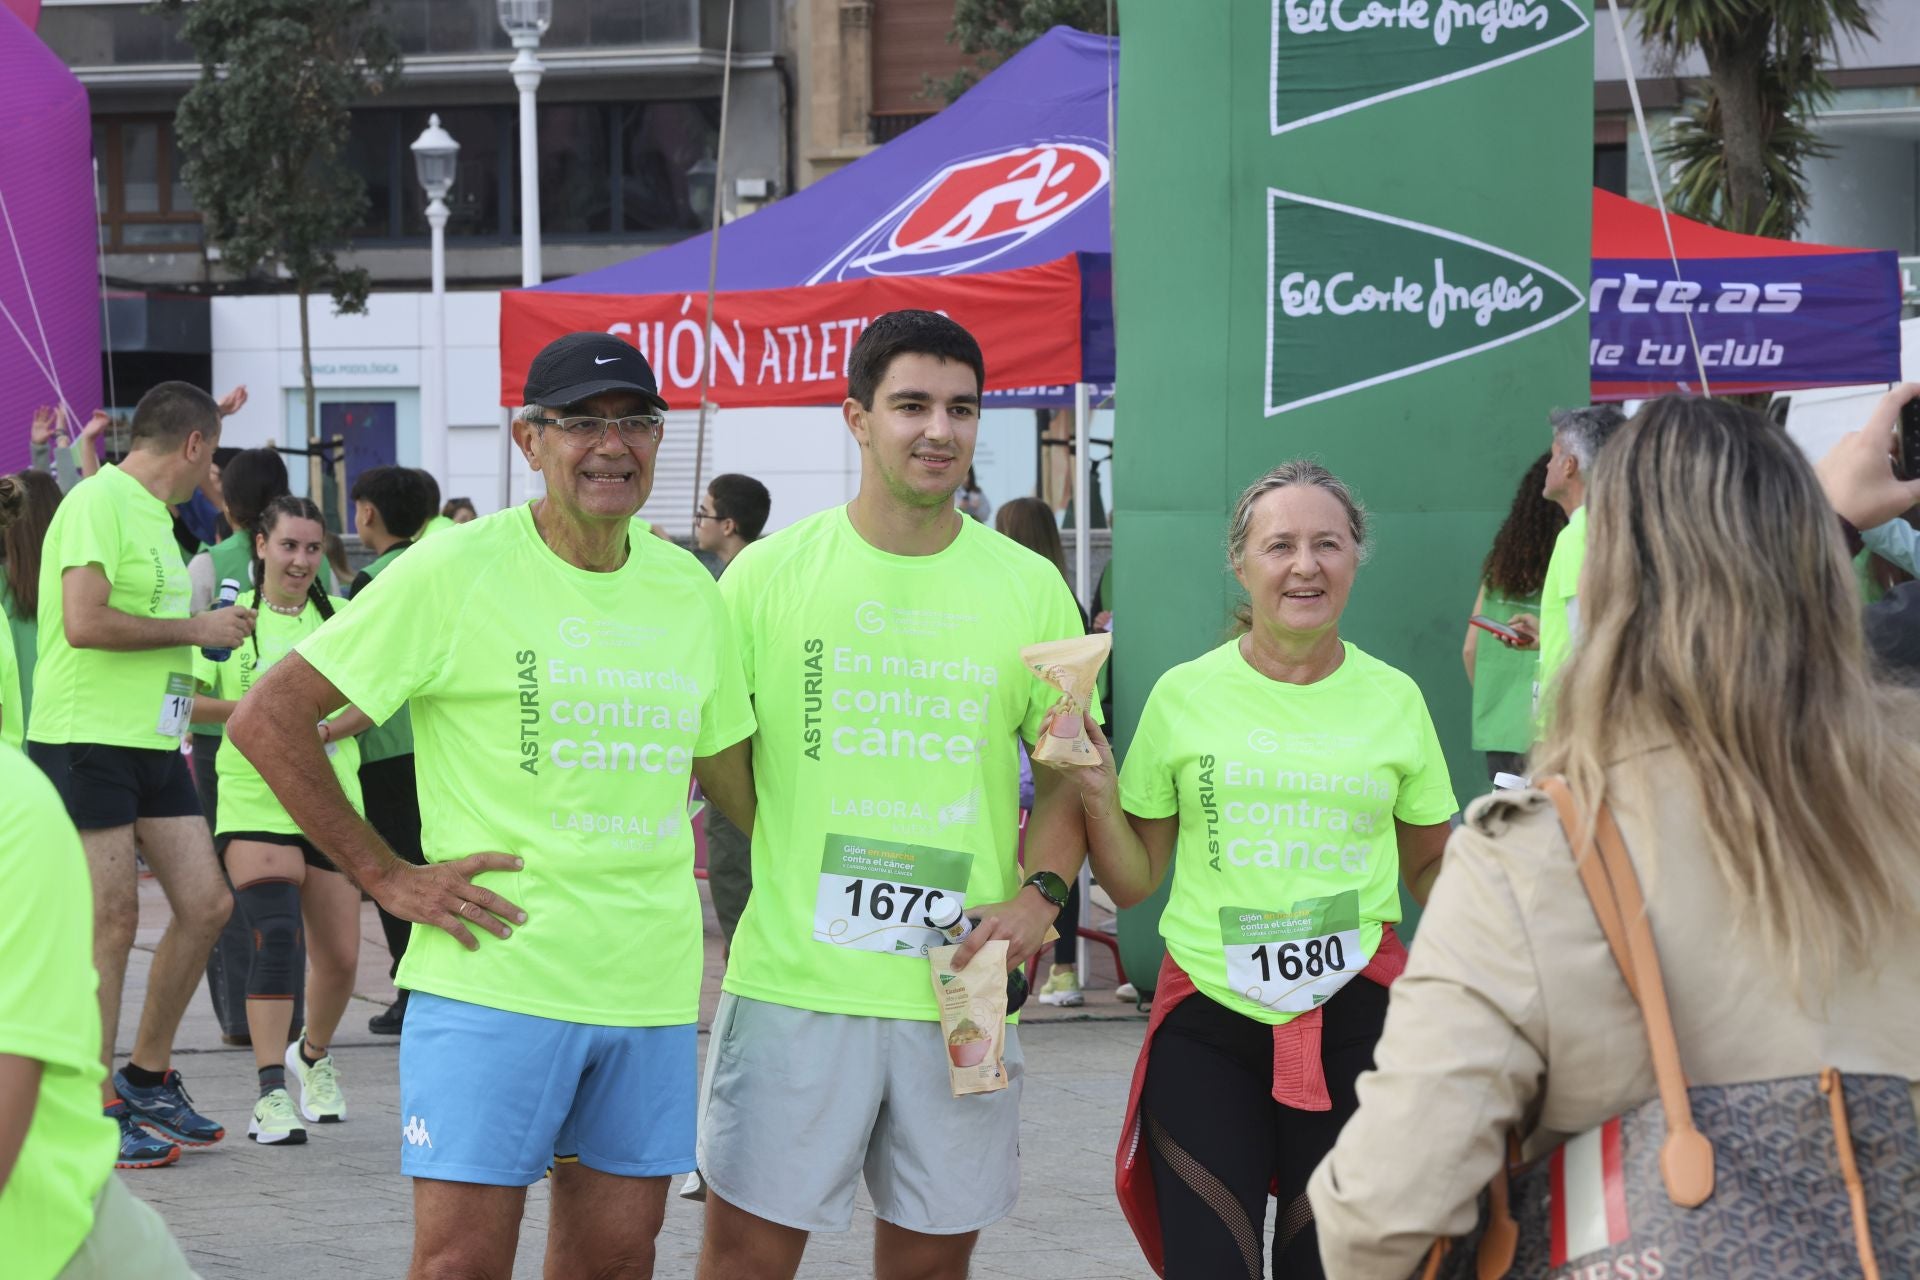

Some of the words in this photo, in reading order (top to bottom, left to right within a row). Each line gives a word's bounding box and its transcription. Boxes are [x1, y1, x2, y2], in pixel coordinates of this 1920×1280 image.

[1285, 0, 1328, 34] El
[1330, 0, 1429, 32] Corte
[1433, 0, 1549, 46] Inglés
[1280, 272, 1323, 317] El
[1324, 272, 1423, 315] Corte
[1428, 258, 1544, 328] Inglés
[607, 294, 746, 396] IJÓN
[1636, 339, 1686, 366] tu
[1702, 339, 1784, 366] club
[149, 547, 165, 614] ASTURIAS
[548, 659, 587, 684] En
[596, 668, 700, 697] marcha
[833, 647, 872, 673] En
[882, 656, 999, 688] marcha
[516, 650, 540, 775] ASTURIAS
[550, 698, 671, 730] contra
[677, 703, 700, 735] el
[804, 638, 823, 761] ASTURIAS
[832, 688, 951, 720] contra
[958, 692, 990, 725] el
[832, 717, 988, 765] cáncer
[1224, 761, 1265, 787] En
[1276, 772, 1390, 800] marcha
[551, 812, 653, 836] LABORAL
[1199, 754, 1221, 873] ASTURIAS
[1224, 798, 1347, 832] contra
[842, 855, 871, 865] contra
[872, 858, 882, 866] el
[883, 860, 915, 871] cáncer
[843, 845, 866, 855] Gijón
[1226, 829, 1373, 873] cáncer
[1239, 913, 1262, 923] Gijón
[1240, 922, 1270, 931] contra
[1270, 920, 1281, 929] el
[1281, 918, 1313, 927] cáncer
[1251, 935, 1346, 982] 1680
[1558, 1247, 1666, 1280] ESS
